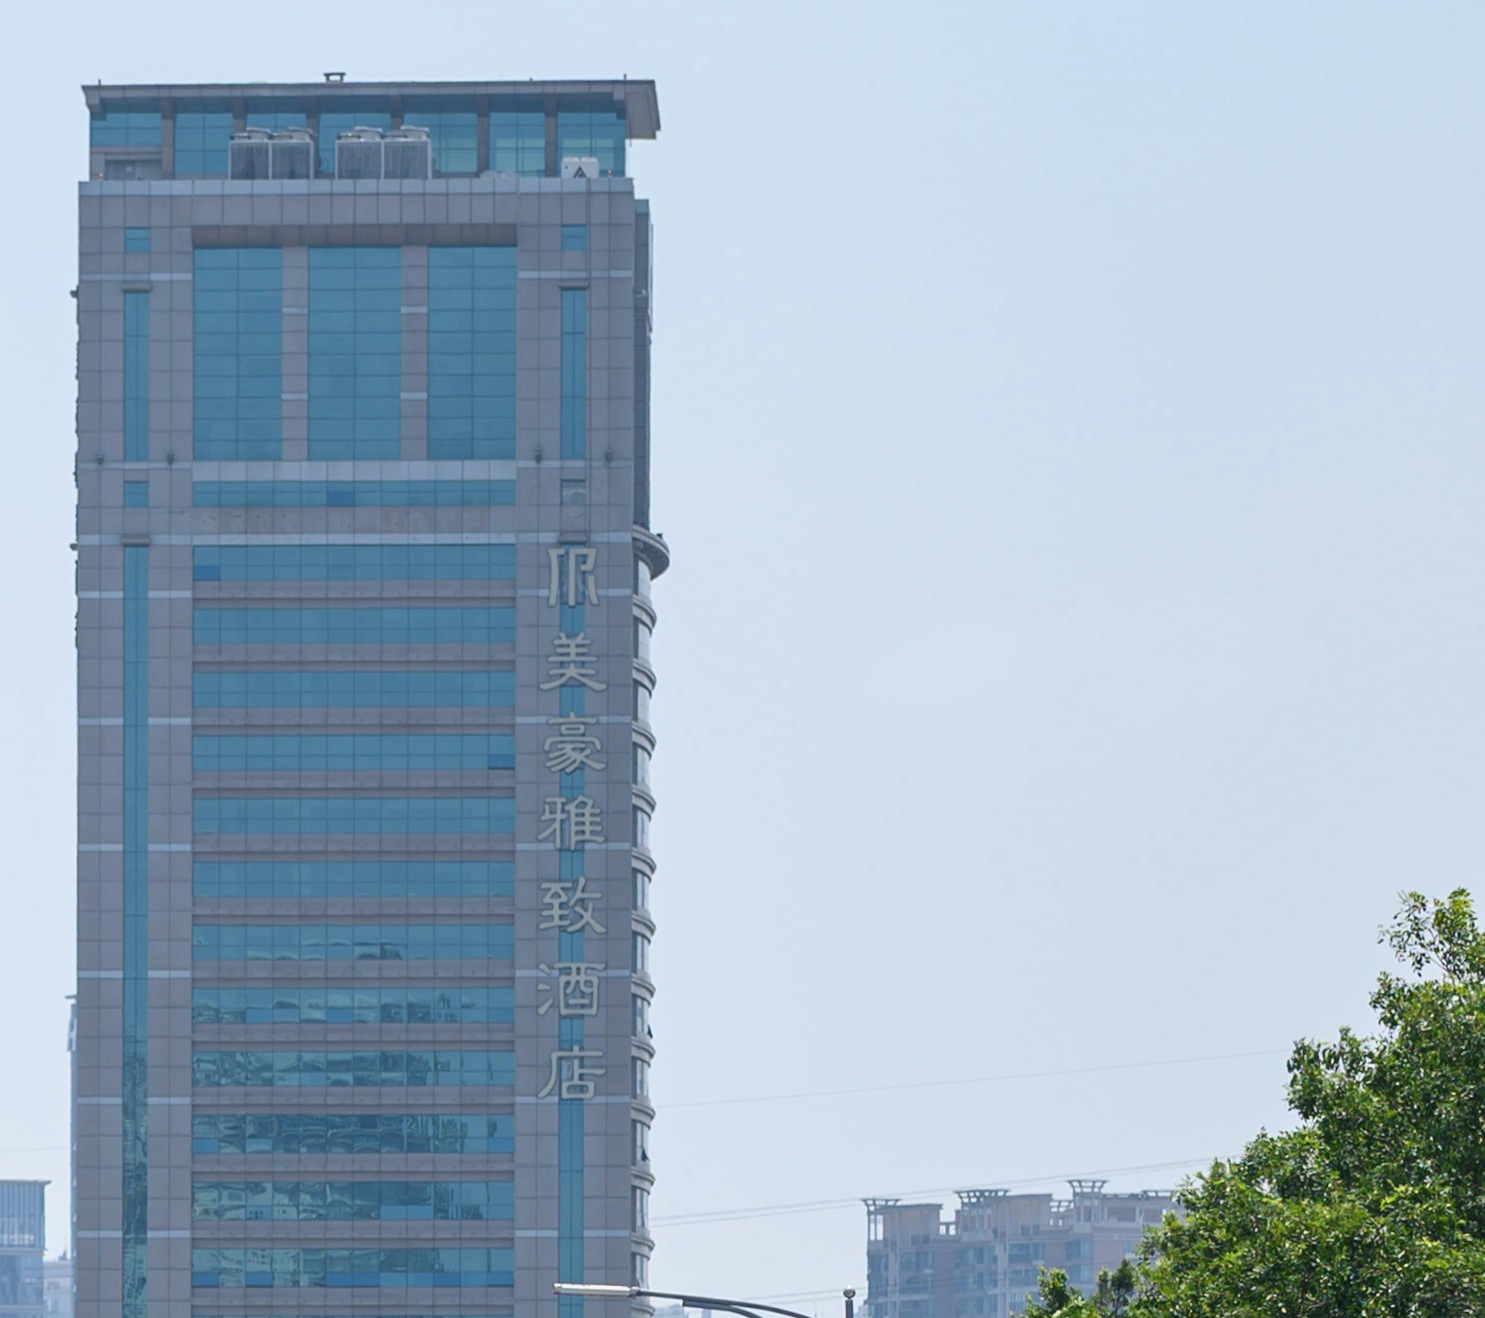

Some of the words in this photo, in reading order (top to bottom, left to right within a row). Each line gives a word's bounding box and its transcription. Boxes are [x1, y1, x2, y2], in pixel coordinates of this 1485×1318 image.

[536, 631, 608, 1101] 美豪雅致酒店
